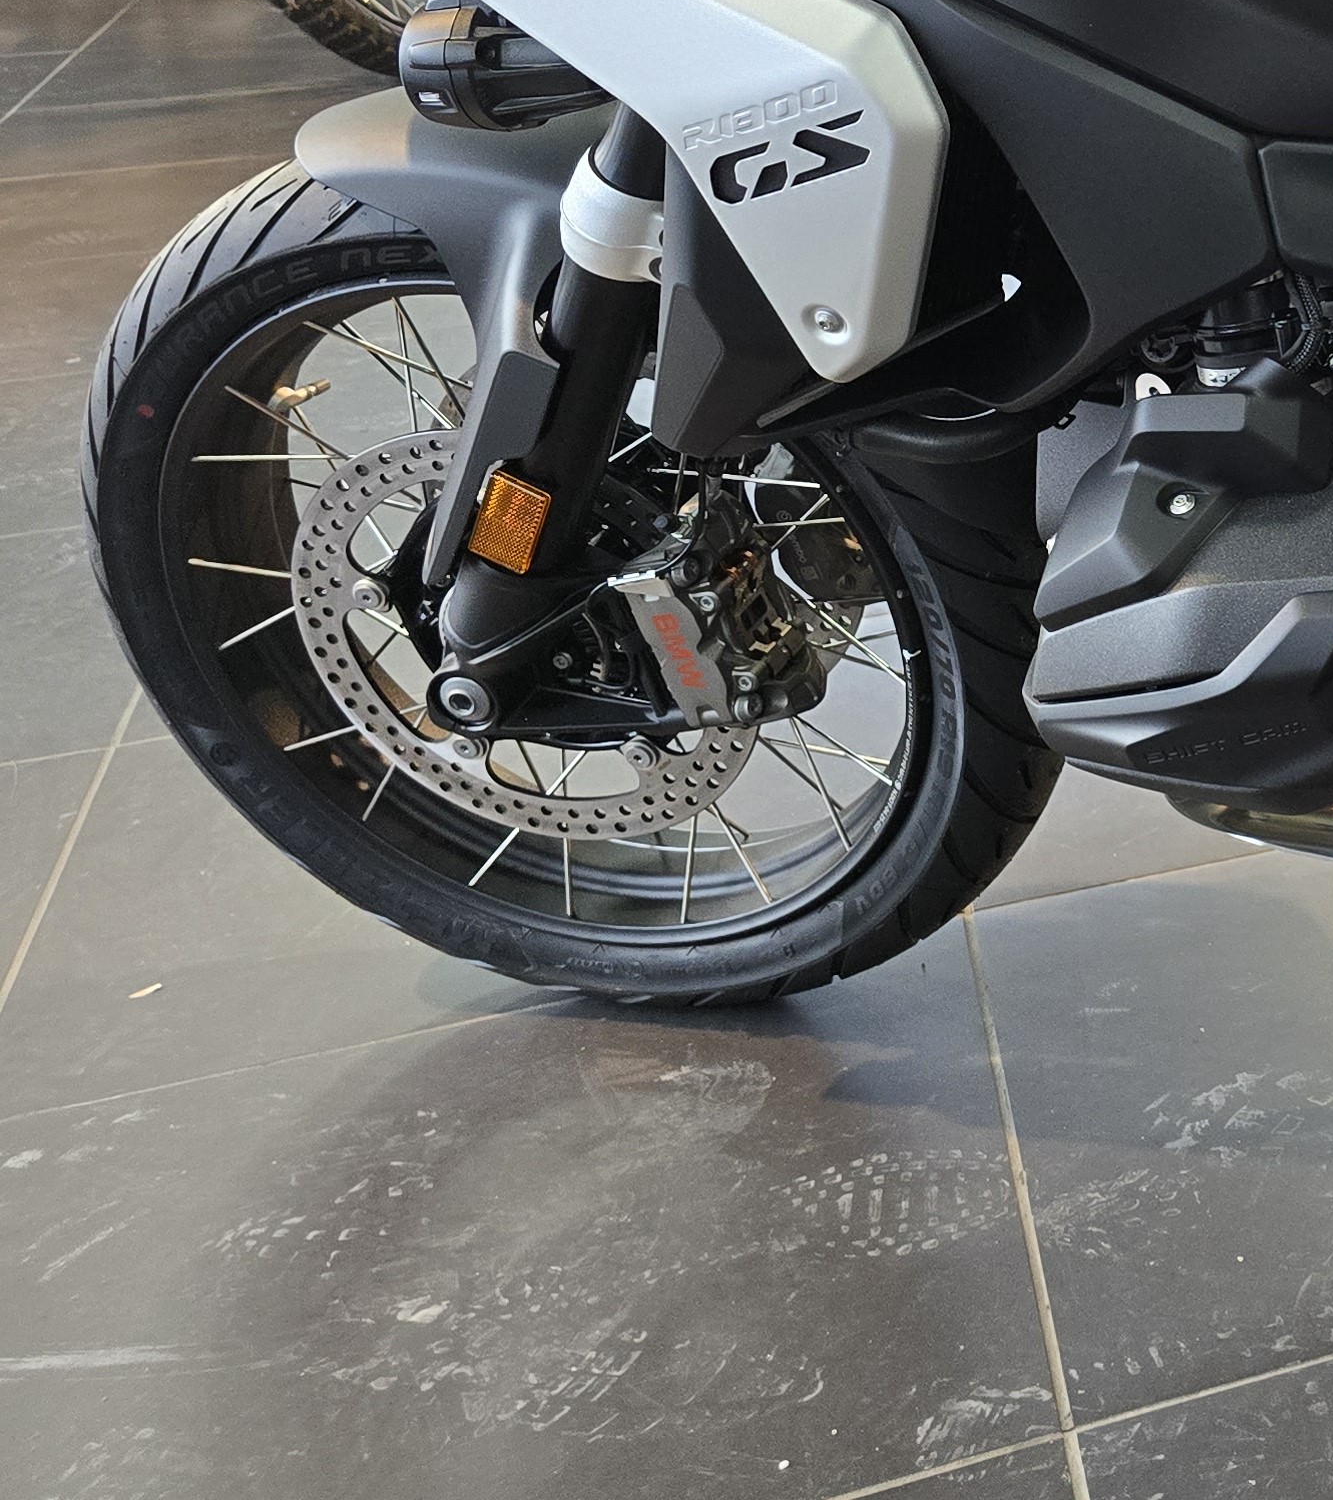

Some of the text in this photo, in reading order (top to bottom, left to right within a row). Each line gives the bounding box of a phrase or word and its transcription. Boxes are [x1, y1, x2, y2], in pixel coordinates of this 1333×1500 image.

[682, 79, 838, 152] R1300
[709, 108, 872, 205] GS
[651, 610, 707, 691] BMW
[1143, 738, 1226, 766] SHIFT
